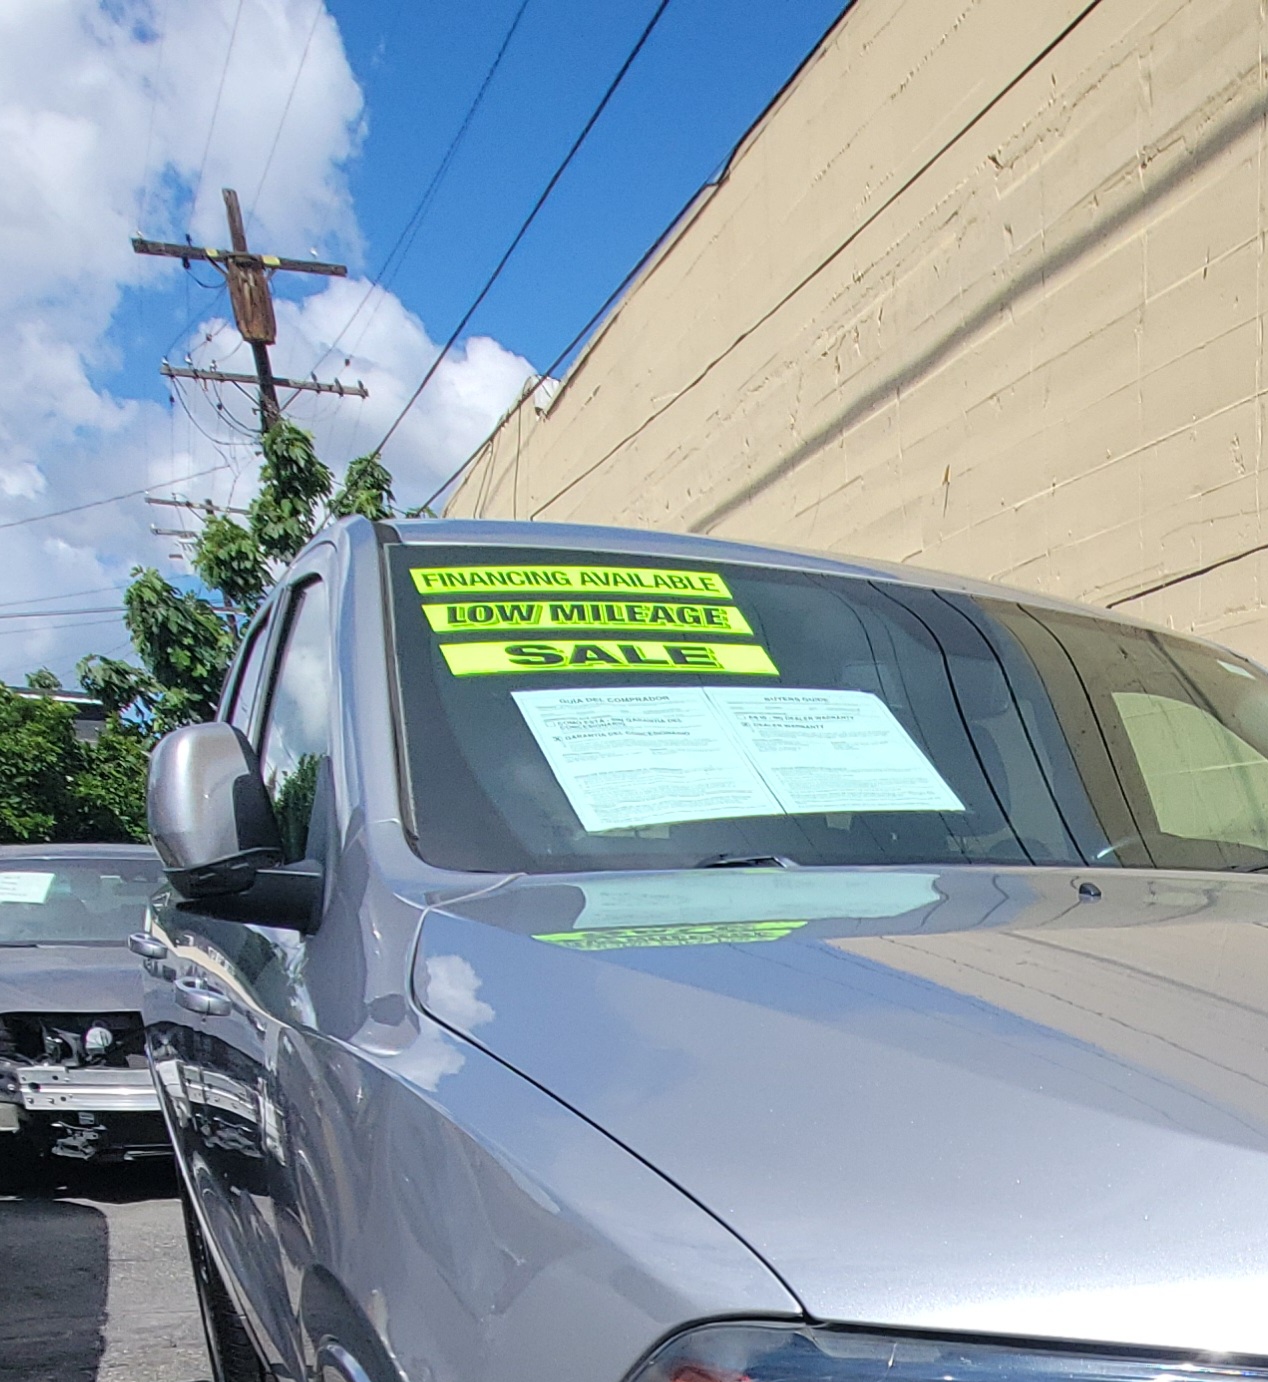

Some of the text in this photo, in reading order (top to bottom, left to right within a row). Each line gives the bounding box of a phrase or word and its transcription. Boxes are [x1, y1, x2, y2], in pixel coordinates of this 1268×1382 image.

[421, 570, 721, 592] FINANCING AVAILABLE
[447, 604, 731, 629] LOW MILEAGE
[504, 644, 725, 669] SALE
[606, 695, 670, 703] COMPRADOR
